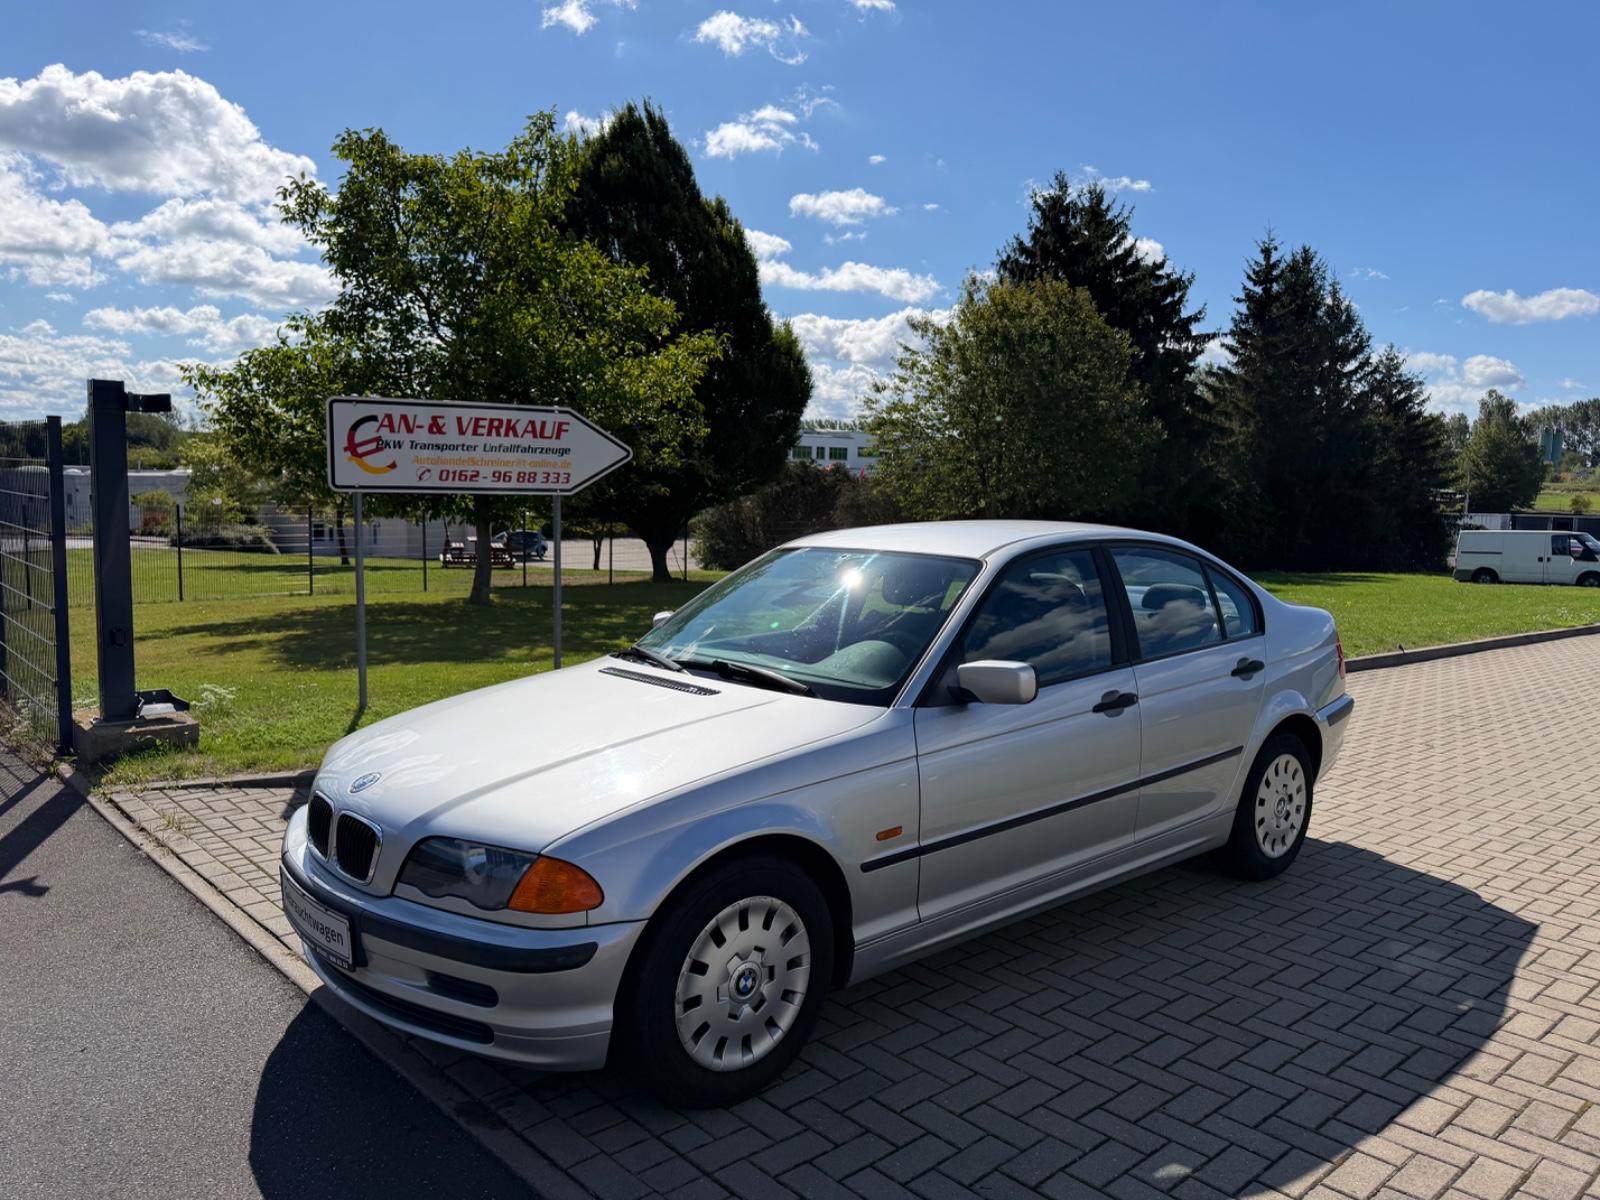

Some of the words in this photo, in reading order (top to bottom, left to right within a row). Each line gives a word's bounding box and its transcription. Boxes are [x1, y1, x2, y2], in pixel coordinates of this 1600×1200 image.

[456, 416, 570, 440] VERKAUF
[376, 439, 404, 450] PKW
[409, 440, 479, 453] Transporter
[483, 443, 571, 456] Unfallfahrzeuge
[439, 469, 480, 482] 0162
[491, 471, 512, 483] 96
[516, 471, 537, 484] 88
[541, 473, 571, 484] 333
